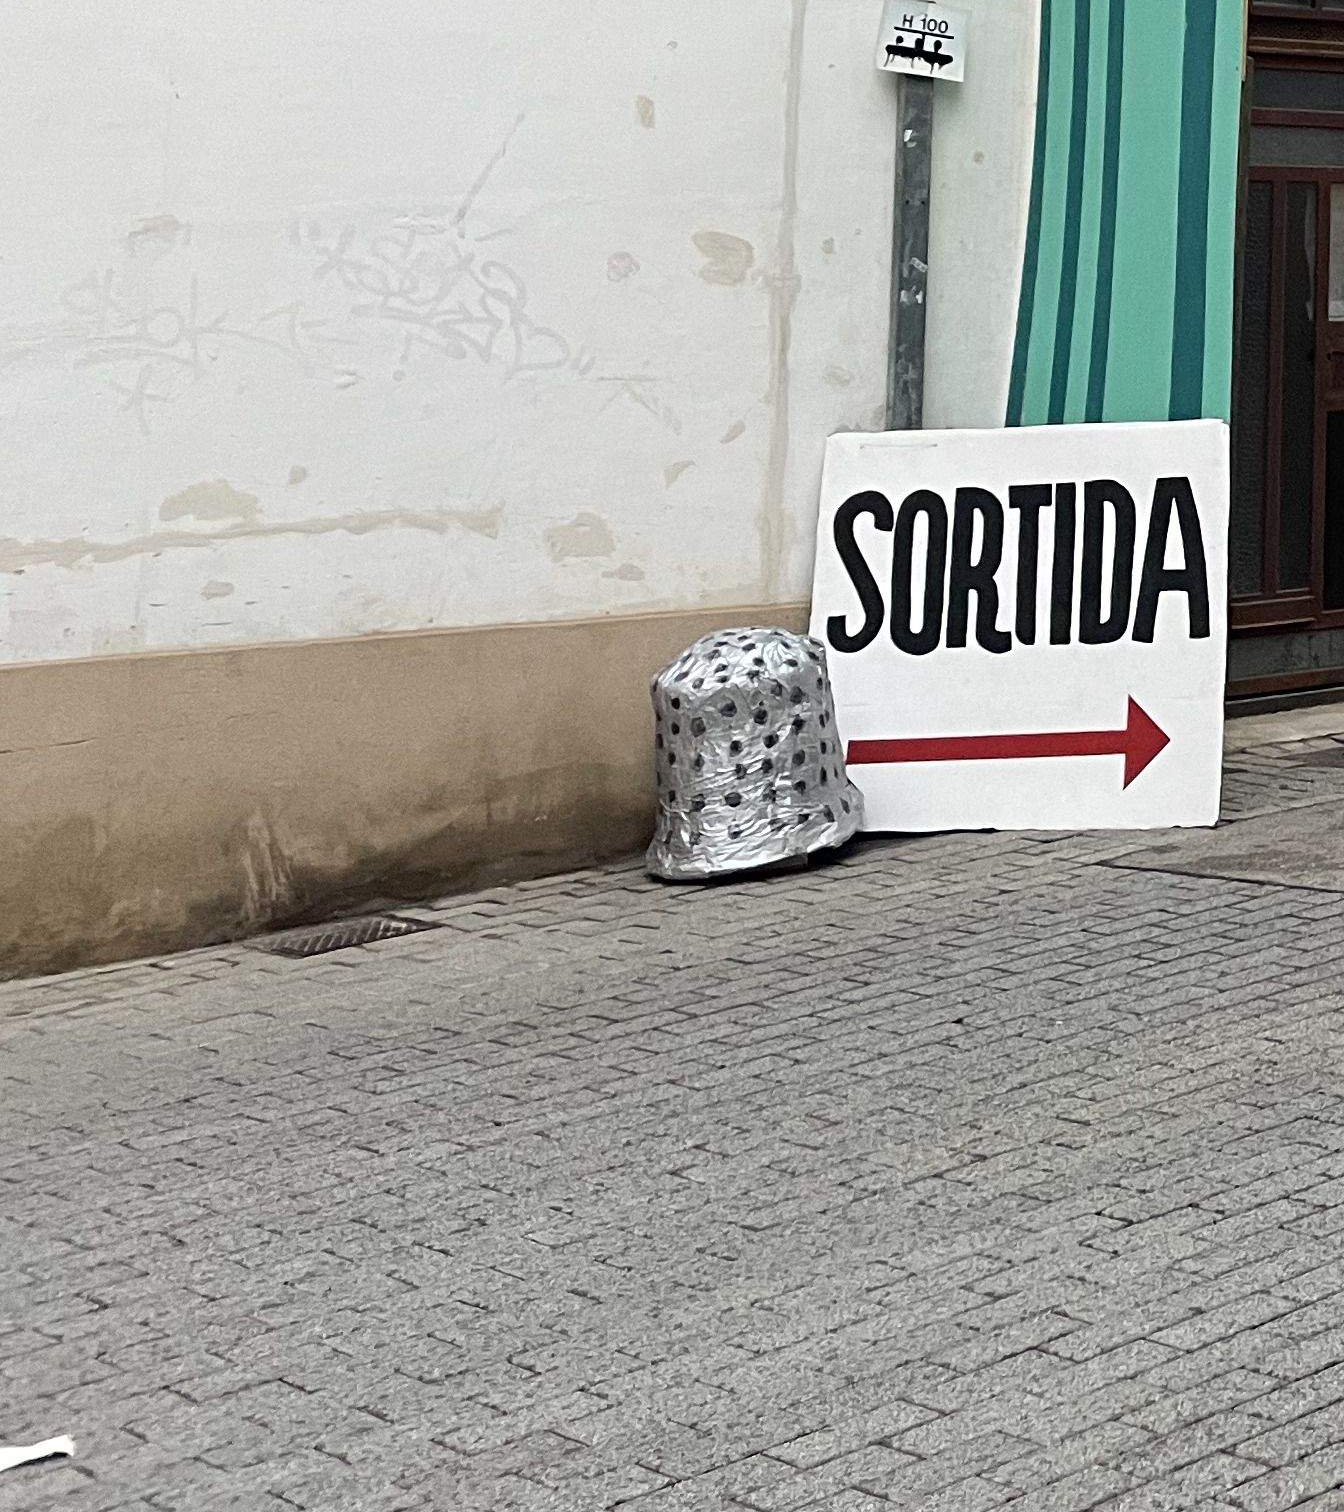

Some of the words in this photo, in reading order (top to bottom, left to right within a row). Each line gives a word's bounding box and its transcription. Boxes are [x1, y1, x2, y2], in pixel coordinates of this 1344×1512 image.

[903, 14, 914, 28] H
[920, 18, 949, 33] 100
[827, 477, 1210, 655] SORTIDA
